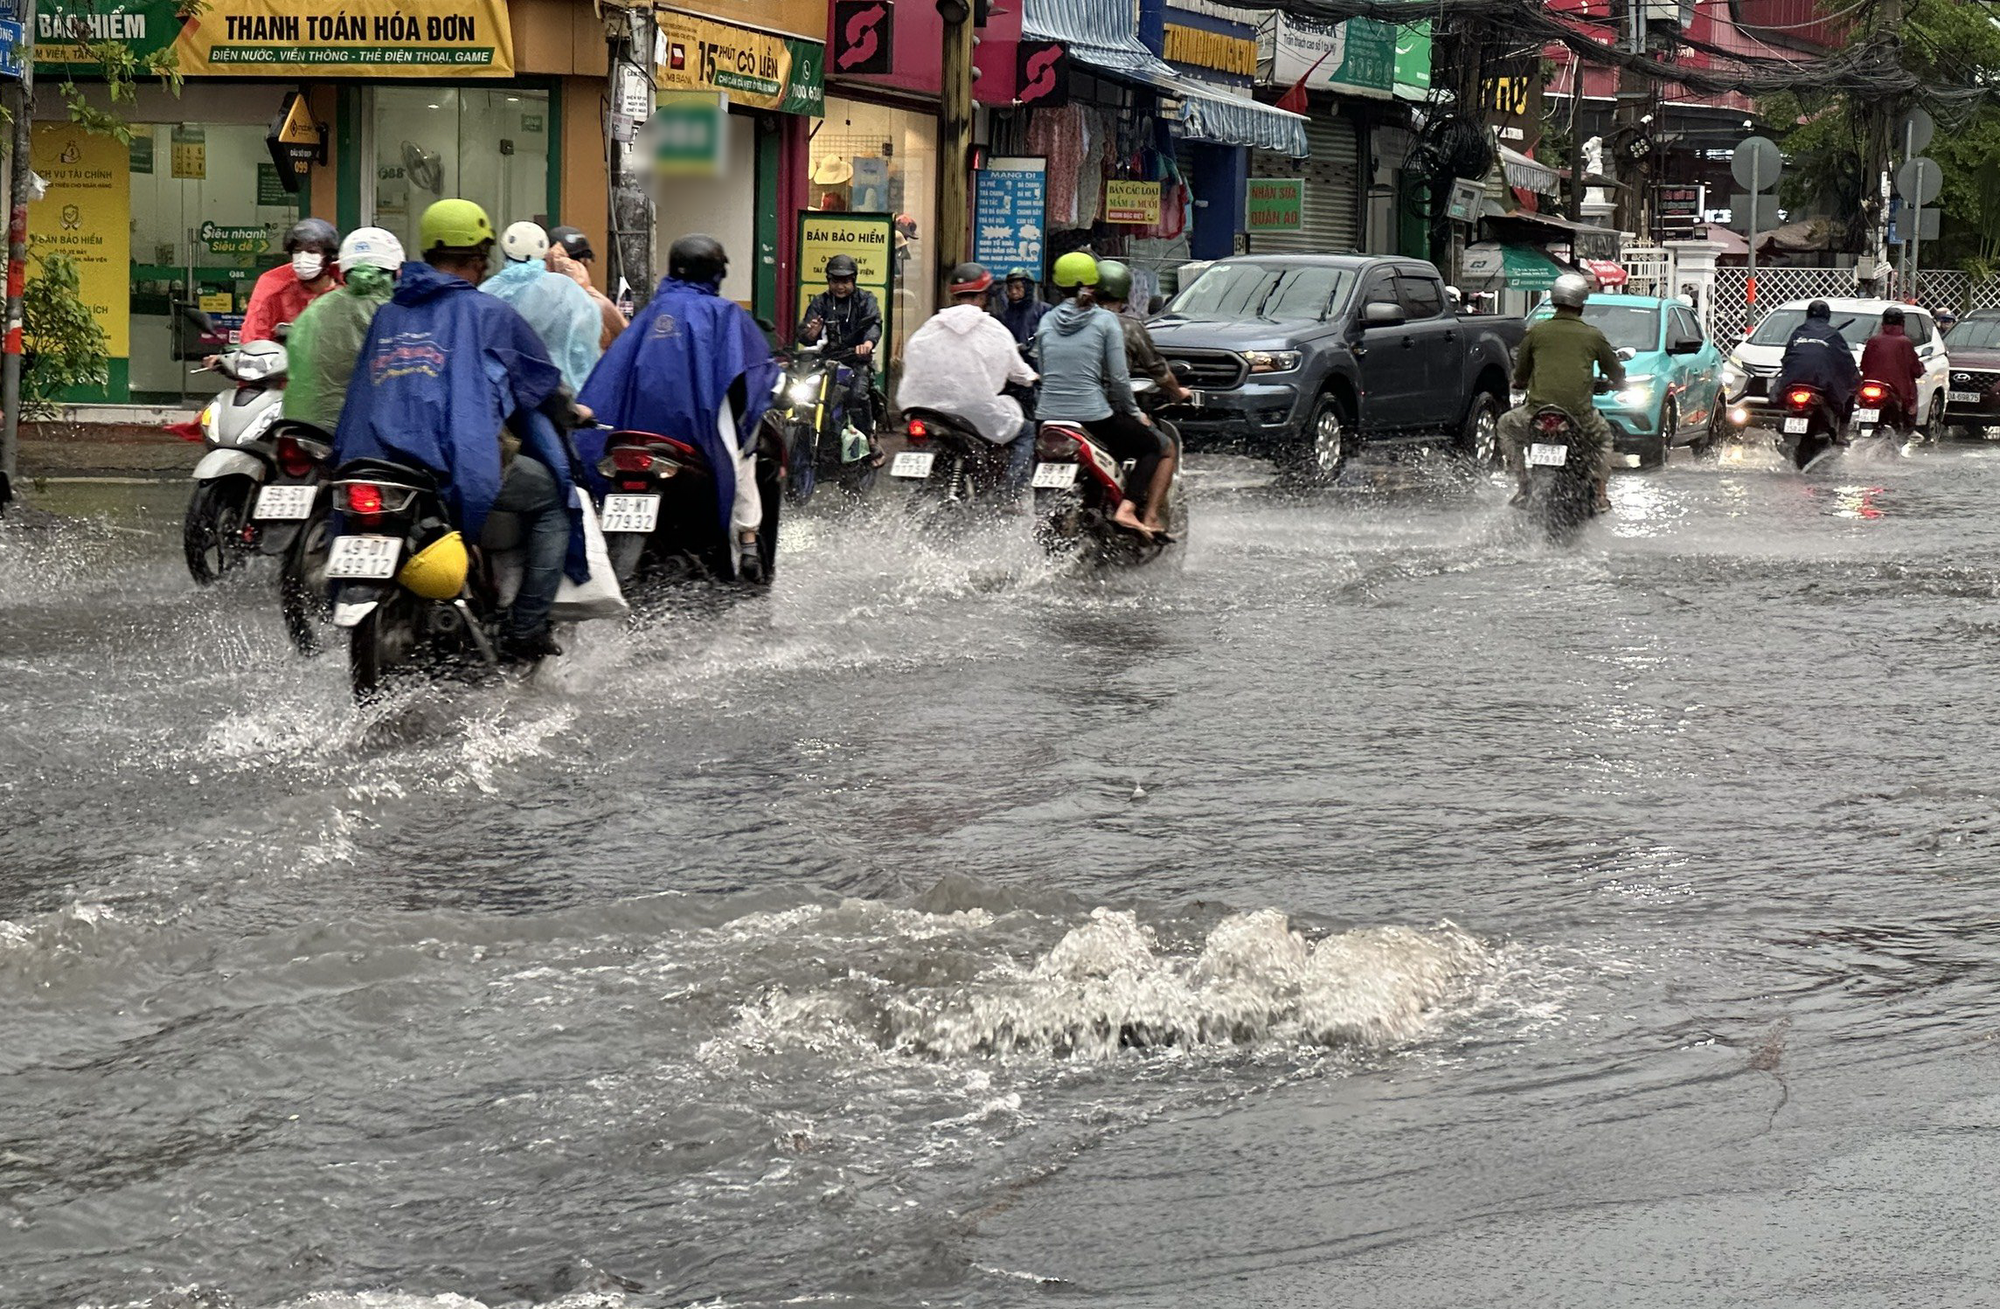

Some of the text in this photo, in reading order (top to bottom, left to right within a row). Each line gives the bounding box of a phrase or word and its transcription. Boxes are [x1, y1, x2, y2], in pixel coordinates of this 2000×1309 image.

[87, 4, 146, 39] HIỂM
[225, 11, 475, 41] THANH TOÁN HÓA ĐƠN
[212, 50, 239, 62] ĐIỆN
[241, 48, 277, 63] NƯỚC,
[308, 50, 349, 62] THÔNG
[359, 48, 382, 62] THẺ
[384, 50, 412, 63] ĐIỆN
[415, 51, 452, 64] THOẠI,
[455, 51, 489, 62] GAME
[698, 40, 719, 84] 15
[718, 43, 779, 79] PHÚT CÓ LIỀN
[84, 168, 113, 179] CHÍNH
[294, 160, 309, 174] 099
[1109, 184, 1125, 195] BÁN
[1126, 184, 1141, 195] CÁC
[60, 233, 79, 244] BẢO
[80, 233, 103, 245] HIỂM
[231, 228, 267, 239] nhanh
[806, 228, 885, 244] BÁN BẢO HIỂM
[212, 241, 236, 252] Siêu
[92, 303, 109, 314] ÍCH
